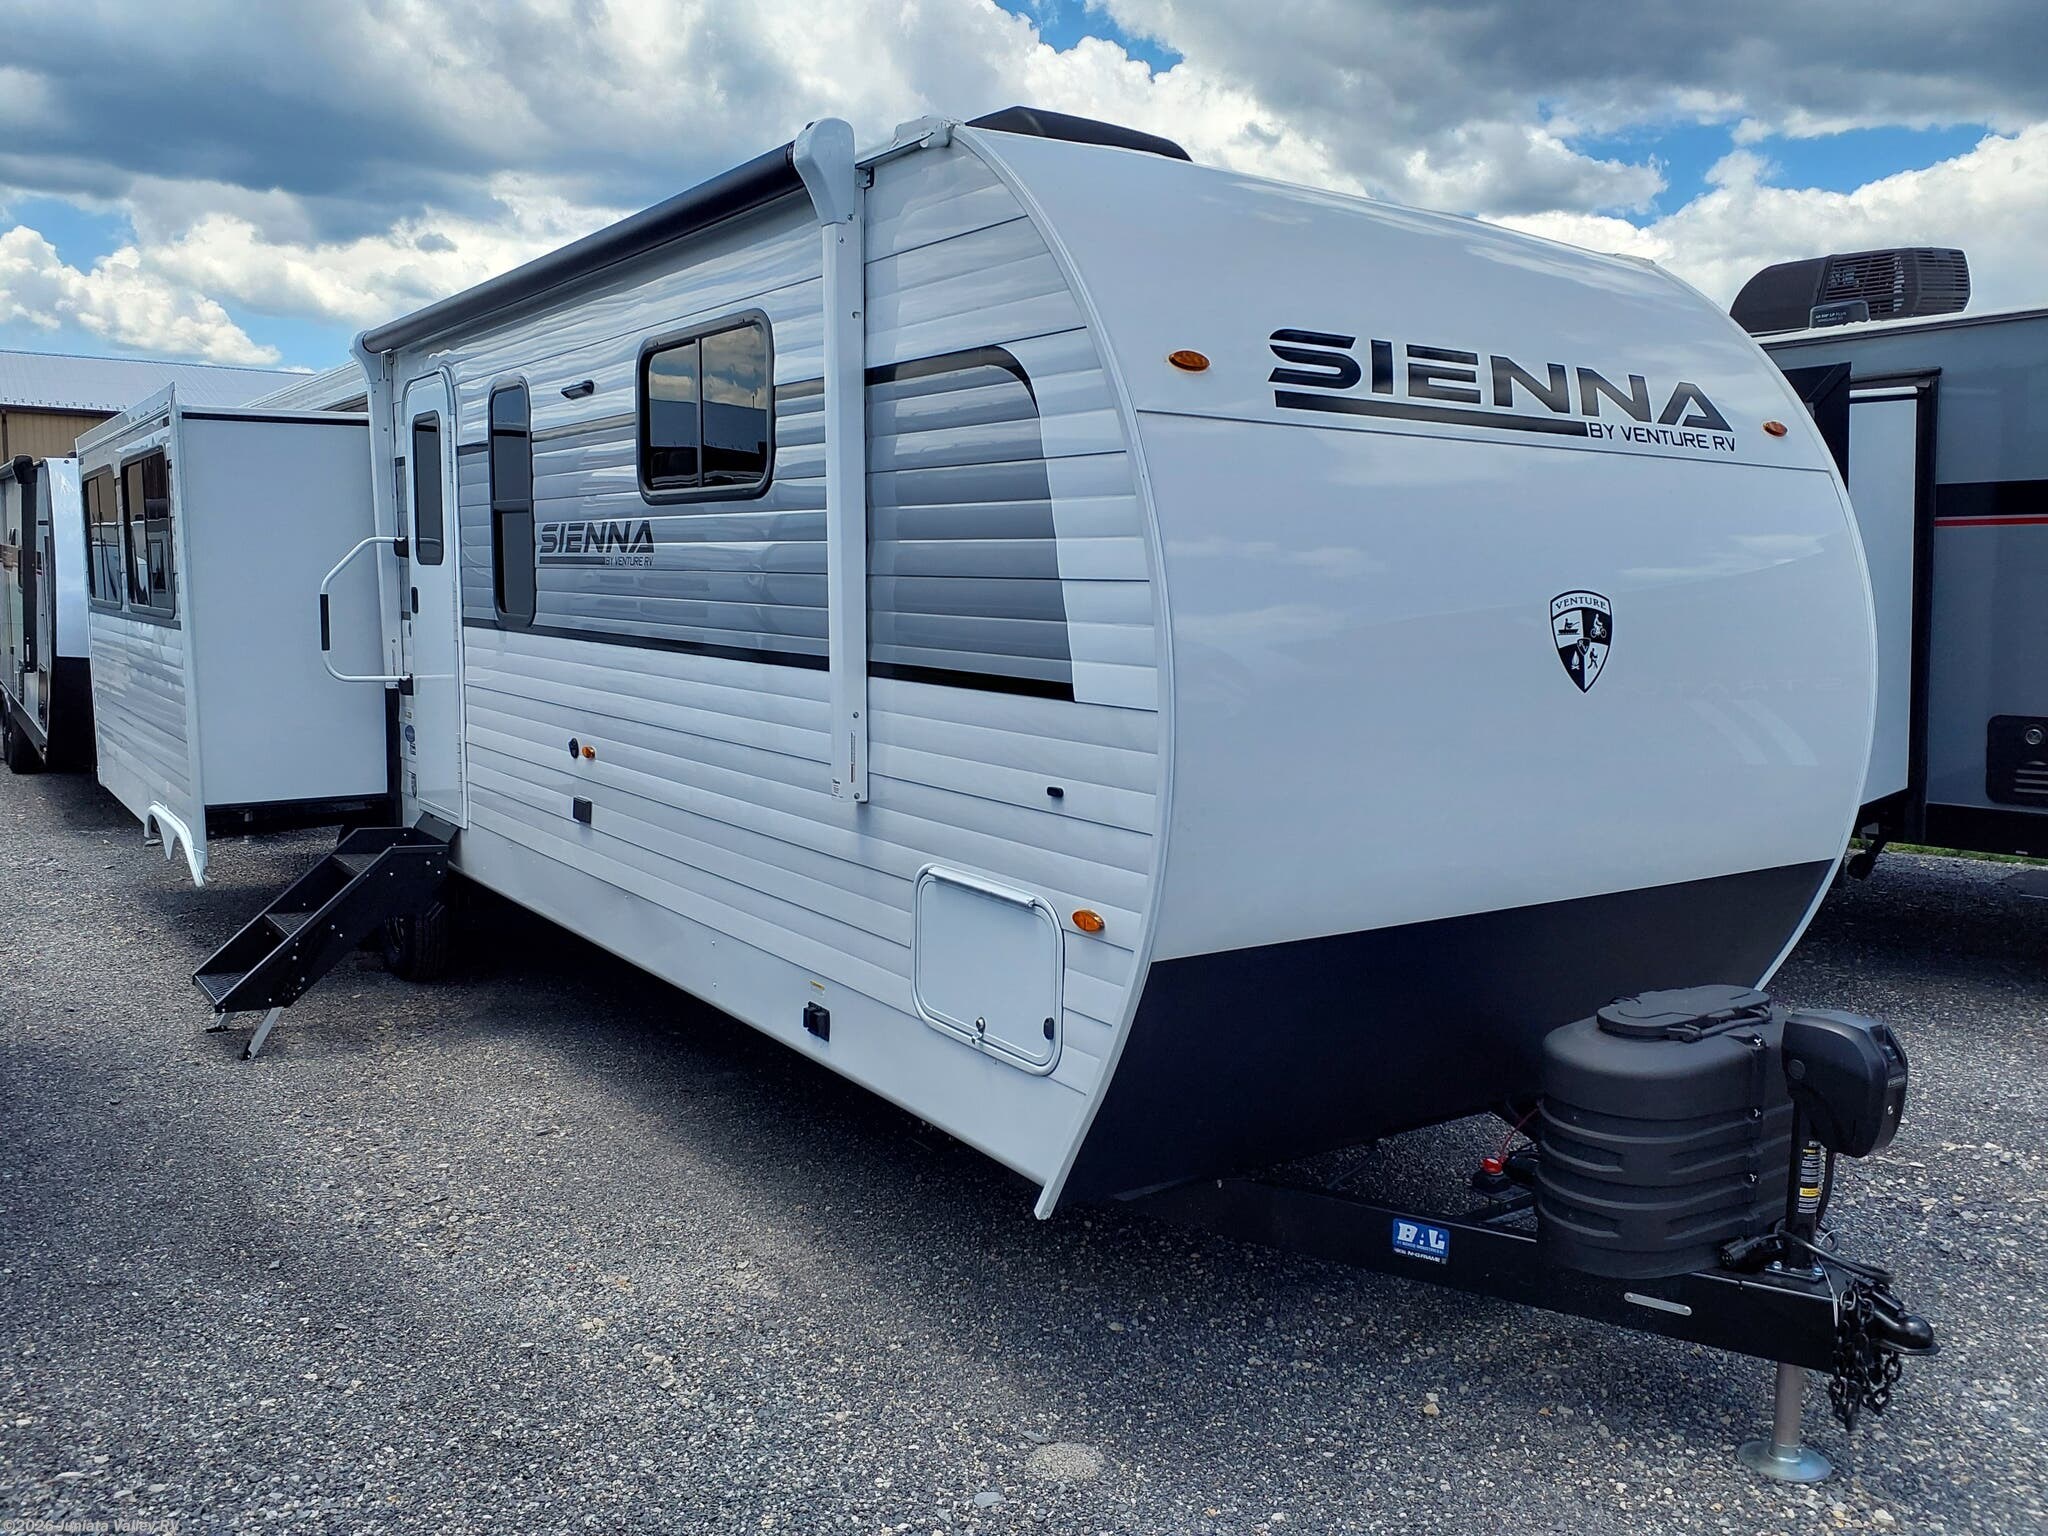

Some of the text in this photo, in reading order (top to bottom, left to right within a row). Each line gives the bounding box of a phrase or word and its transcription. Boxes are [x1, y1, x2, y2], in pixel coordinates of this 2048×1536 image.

[1268, 328, 1733, 432] SIENNA
[1589, 422, 1735, 451] BY VENTURE RV
[540, 520, 655, 553] SIENNA
[613, 556, 644, 567] VENTURE
[1555, 596, 1607, 610] VENTURE
